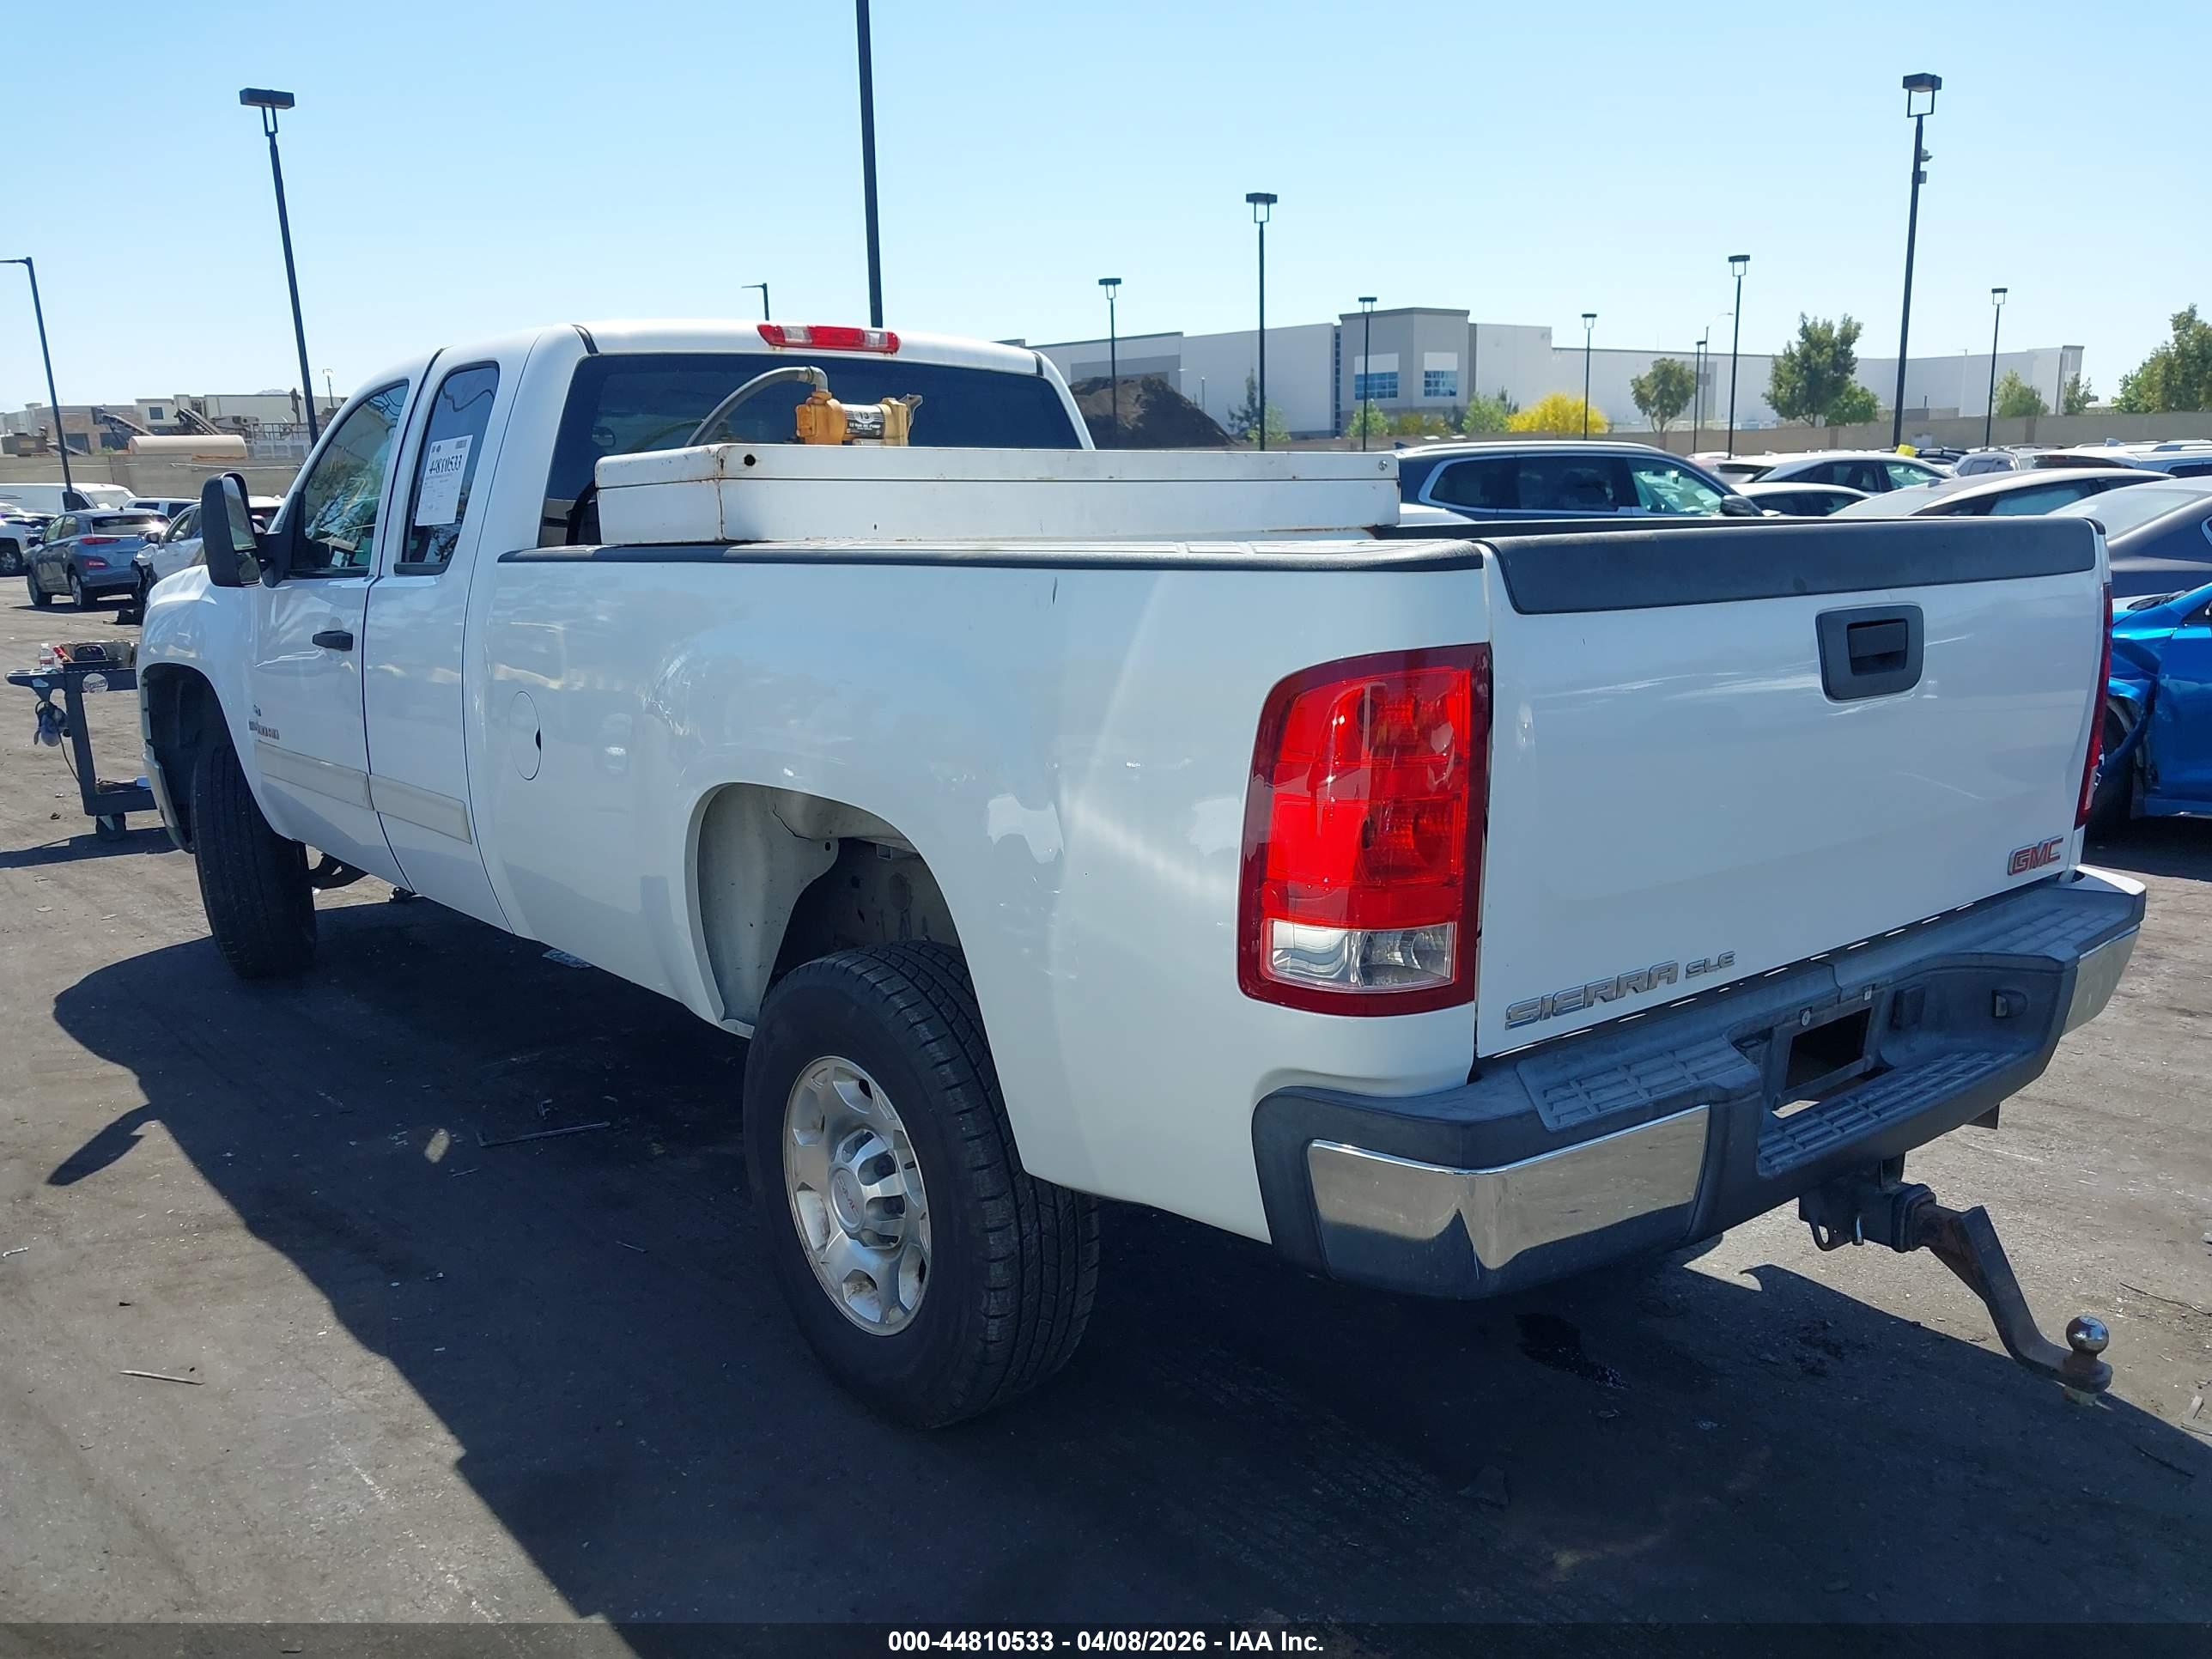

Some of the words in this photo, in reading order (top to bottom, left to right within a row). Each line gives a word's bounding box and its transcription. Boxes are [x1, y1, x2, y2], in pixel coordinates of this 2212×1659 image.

[2007, 835, 2064, 876] GMC
[1504, 960, 1679, 1030] SIERRA
[1686, 951, 1736, 980] SLE
